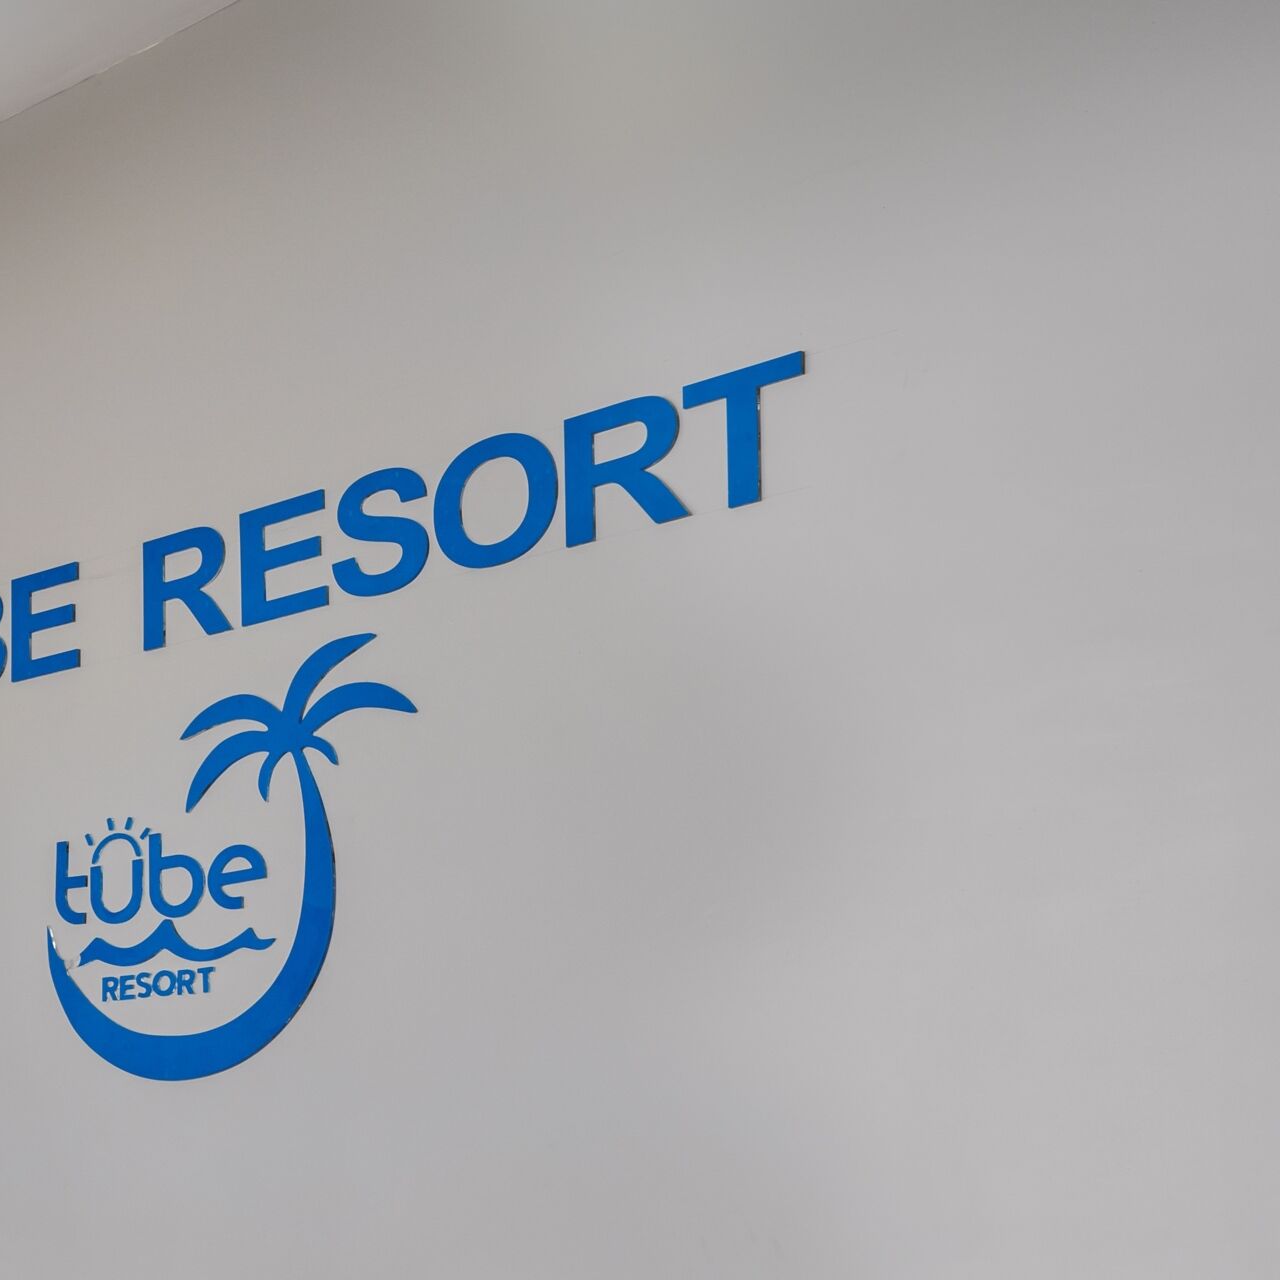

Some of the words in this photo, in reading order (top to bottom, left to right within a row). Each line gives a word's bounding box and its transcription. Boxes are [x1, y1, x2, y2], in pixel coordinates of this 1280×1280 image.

[143, 351, 806, 651] RESORT
[54, 832, 268, 926] tube
[101, 966, 216, 1002] RESORT
